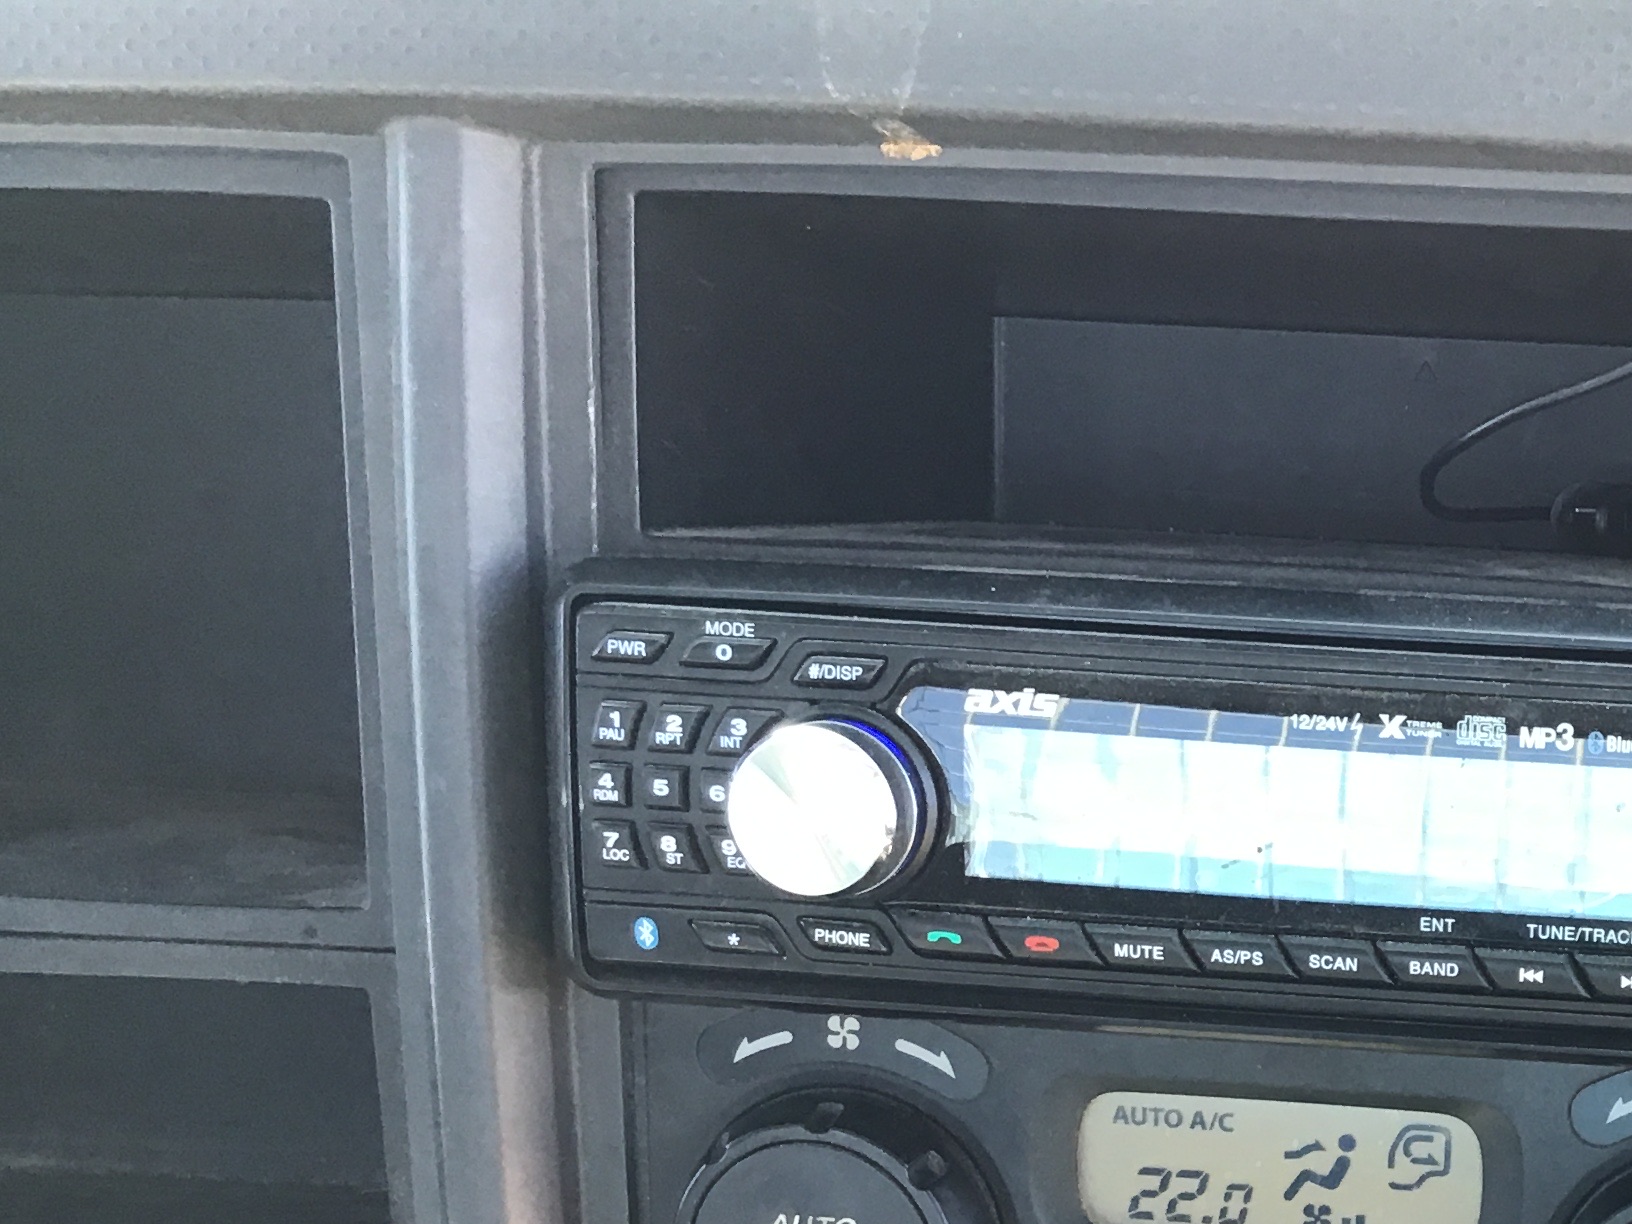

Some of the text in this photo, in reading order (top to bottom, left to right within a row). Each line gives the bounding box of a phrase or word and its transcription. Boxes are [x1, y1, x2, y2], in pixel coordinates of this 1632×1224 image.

[705, 621, 755, 638] MODE
[607, 639, 646, 657] PWR
[808, 664, 863, 682] #/DISP
[963, 687, 1060, 718] axis
[609, 711, 621, 728] 1
[666, 714, 683, 732] 2
[730, 718, 747, 736] 3
[1289, 713, 1349, 732] 12/24V
[599, 728, 625, 742] PAU
[655, 731, 683, 746] RPT
[719, 735, 743, 749] INT
[1519, 722, 1575, 752] MP3
[598, 773, 614, 789] 4
[653, 780, 669, 796] 5
[593, 788, 619, 802] RDM
[709, 785, 726, 802] 6
[603, 832, 620, 848] 7
[660, 835, 677, 851] 8
[721, 839, 737, 856] 9
[603, 848, 630, 862] LOC
[666, 852, 684, 866] ST
[726, 856, 746, 870] EQ
[1420, 916, 1455, 934] ENT
[814, 928, 871, 948] PHONE
[1114, 943, 1165, 961] MUTE
[1210, 949, 1264, 966] AS/PS
[1309, 954, 1358, 972] SCAN
[1409, 961, 1459, 977] BAND
[1112, 1104, 1236, 1133] AUTO A/C
